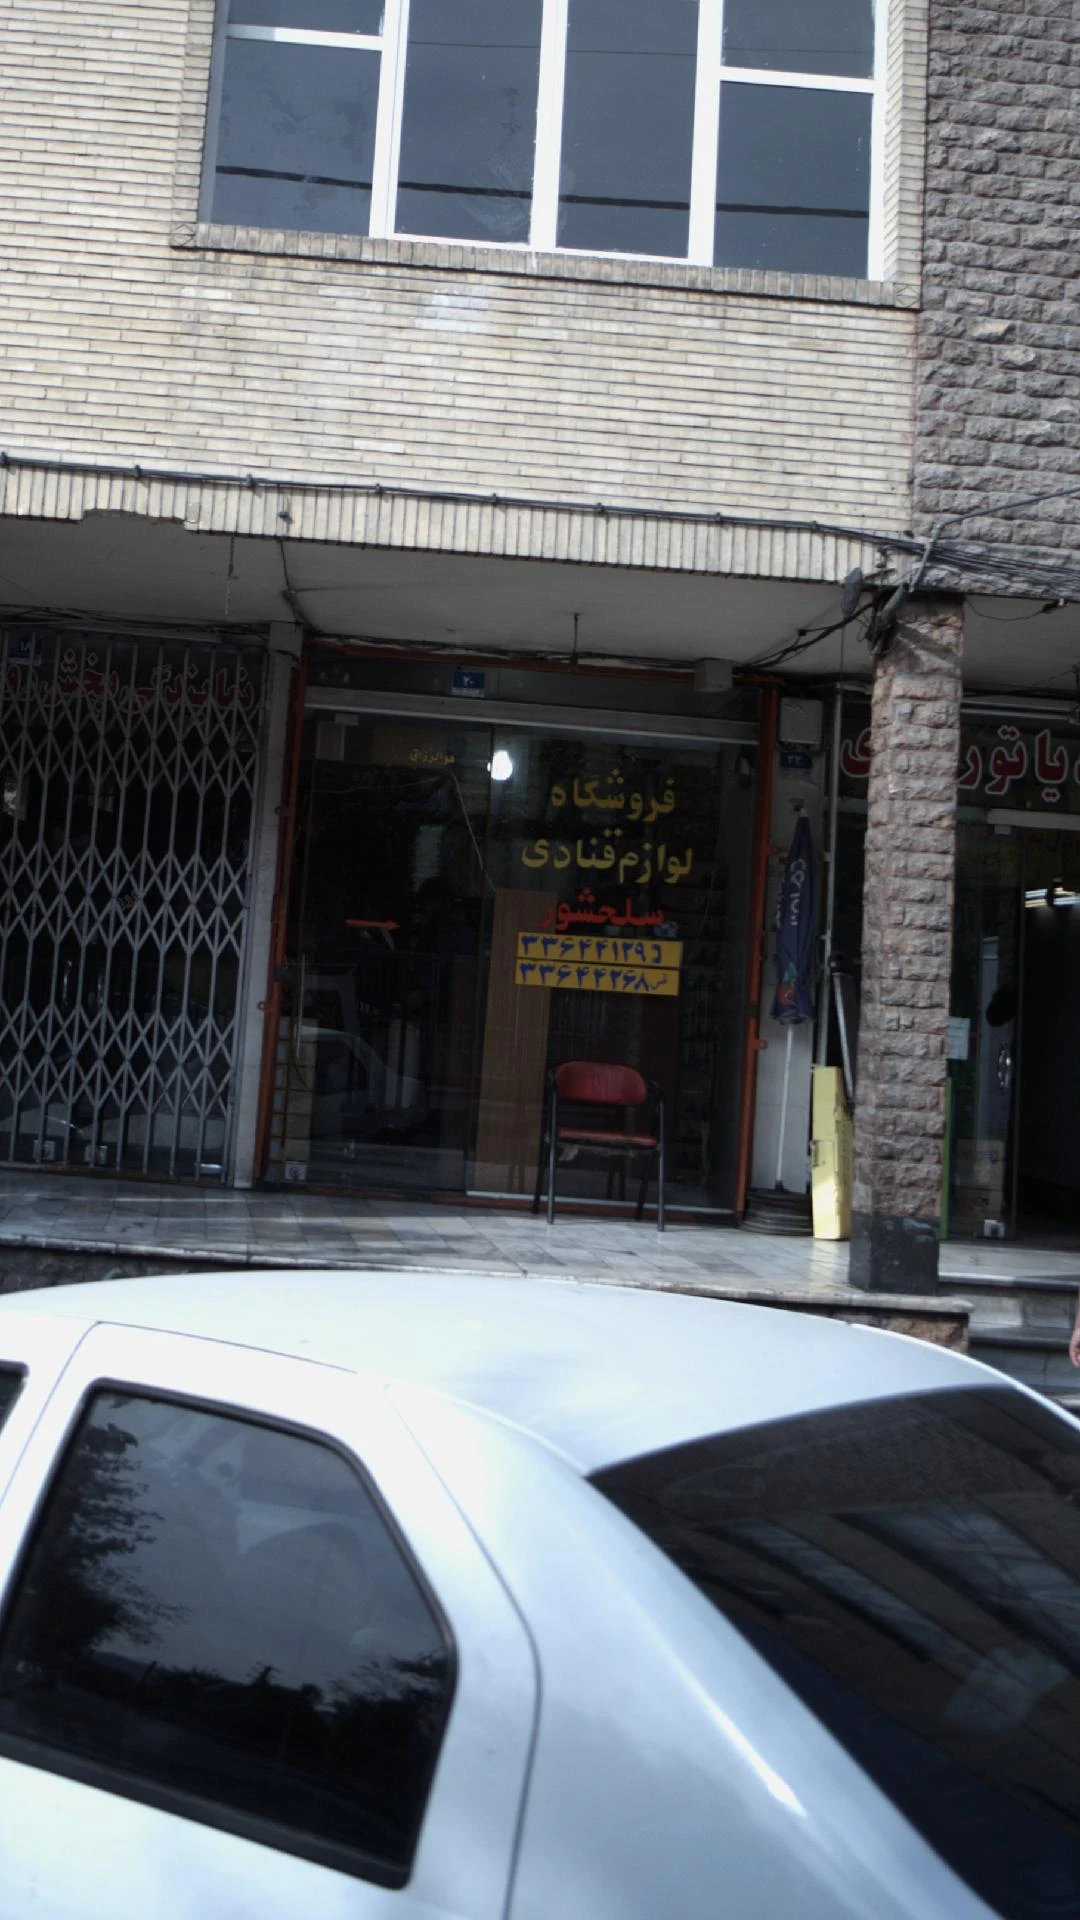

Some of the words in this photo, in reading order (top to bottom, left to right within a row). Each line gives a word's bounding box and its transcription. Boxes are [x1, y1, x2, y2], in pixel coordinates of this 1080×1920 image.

[957, 725, 1080, 803] یاتور
[550, 768, 677, 822] فروشگاه
[521, 828, 623, 869] قنادی
[618, 842, 693, 884] لوازم
[540, 886, 665, 931] سلحشور
